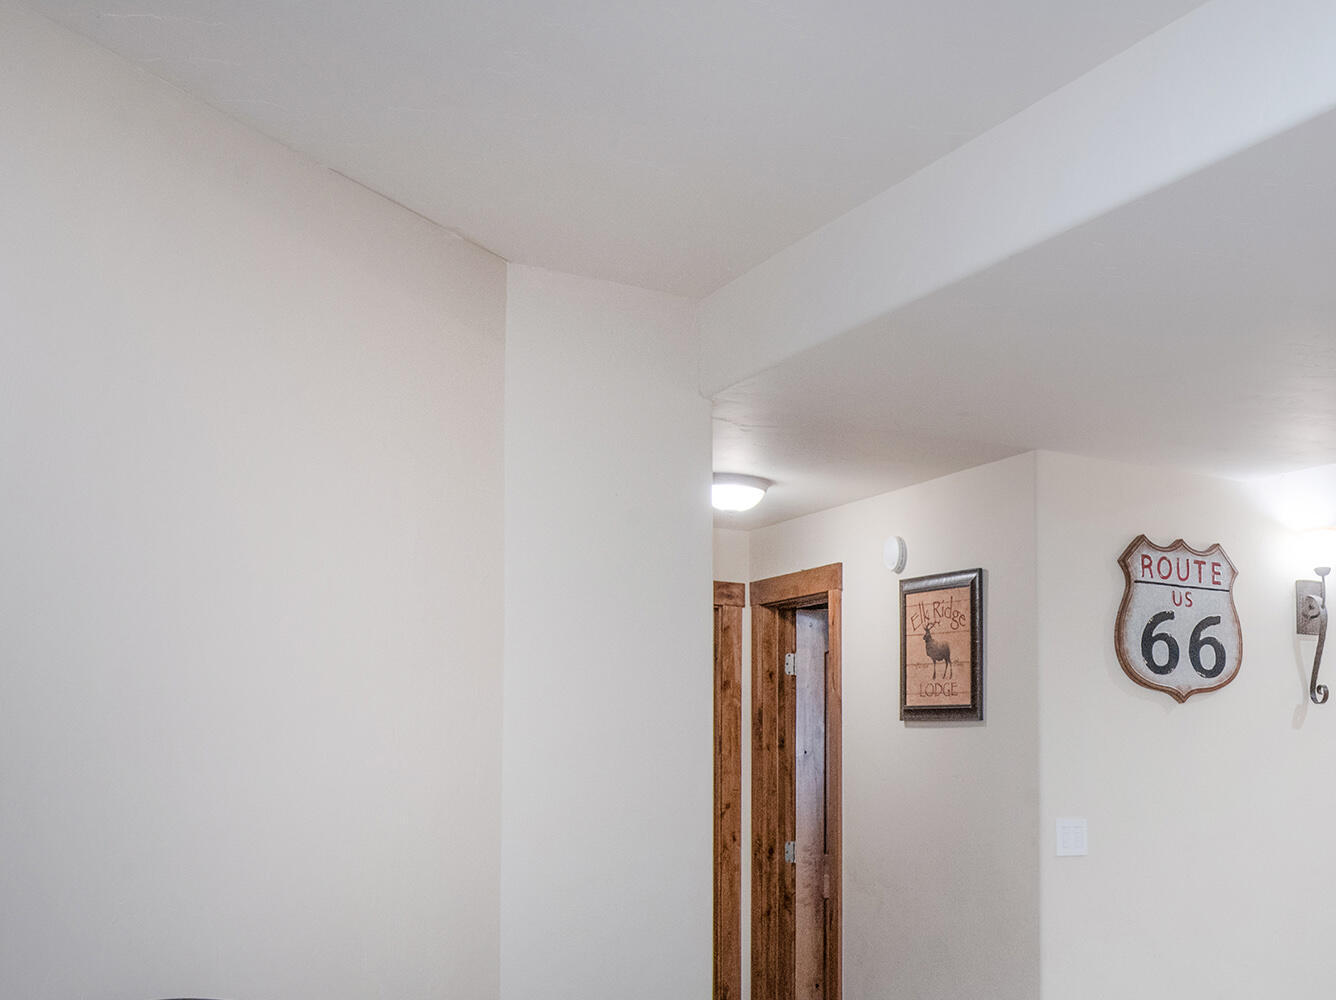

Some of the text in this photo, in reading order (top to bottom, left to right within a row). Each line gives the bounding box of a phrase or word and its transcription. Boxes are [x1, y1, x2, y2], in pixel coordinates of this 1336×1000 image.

[1140, 554, 1222, 586] ROUTE
[910, 595, 967, 632] Elk Ridge
[1171, 590, 1194, 608] US
[1140, 610, 1227, 679] 66
[919, 681, 959, 698] LODGE
